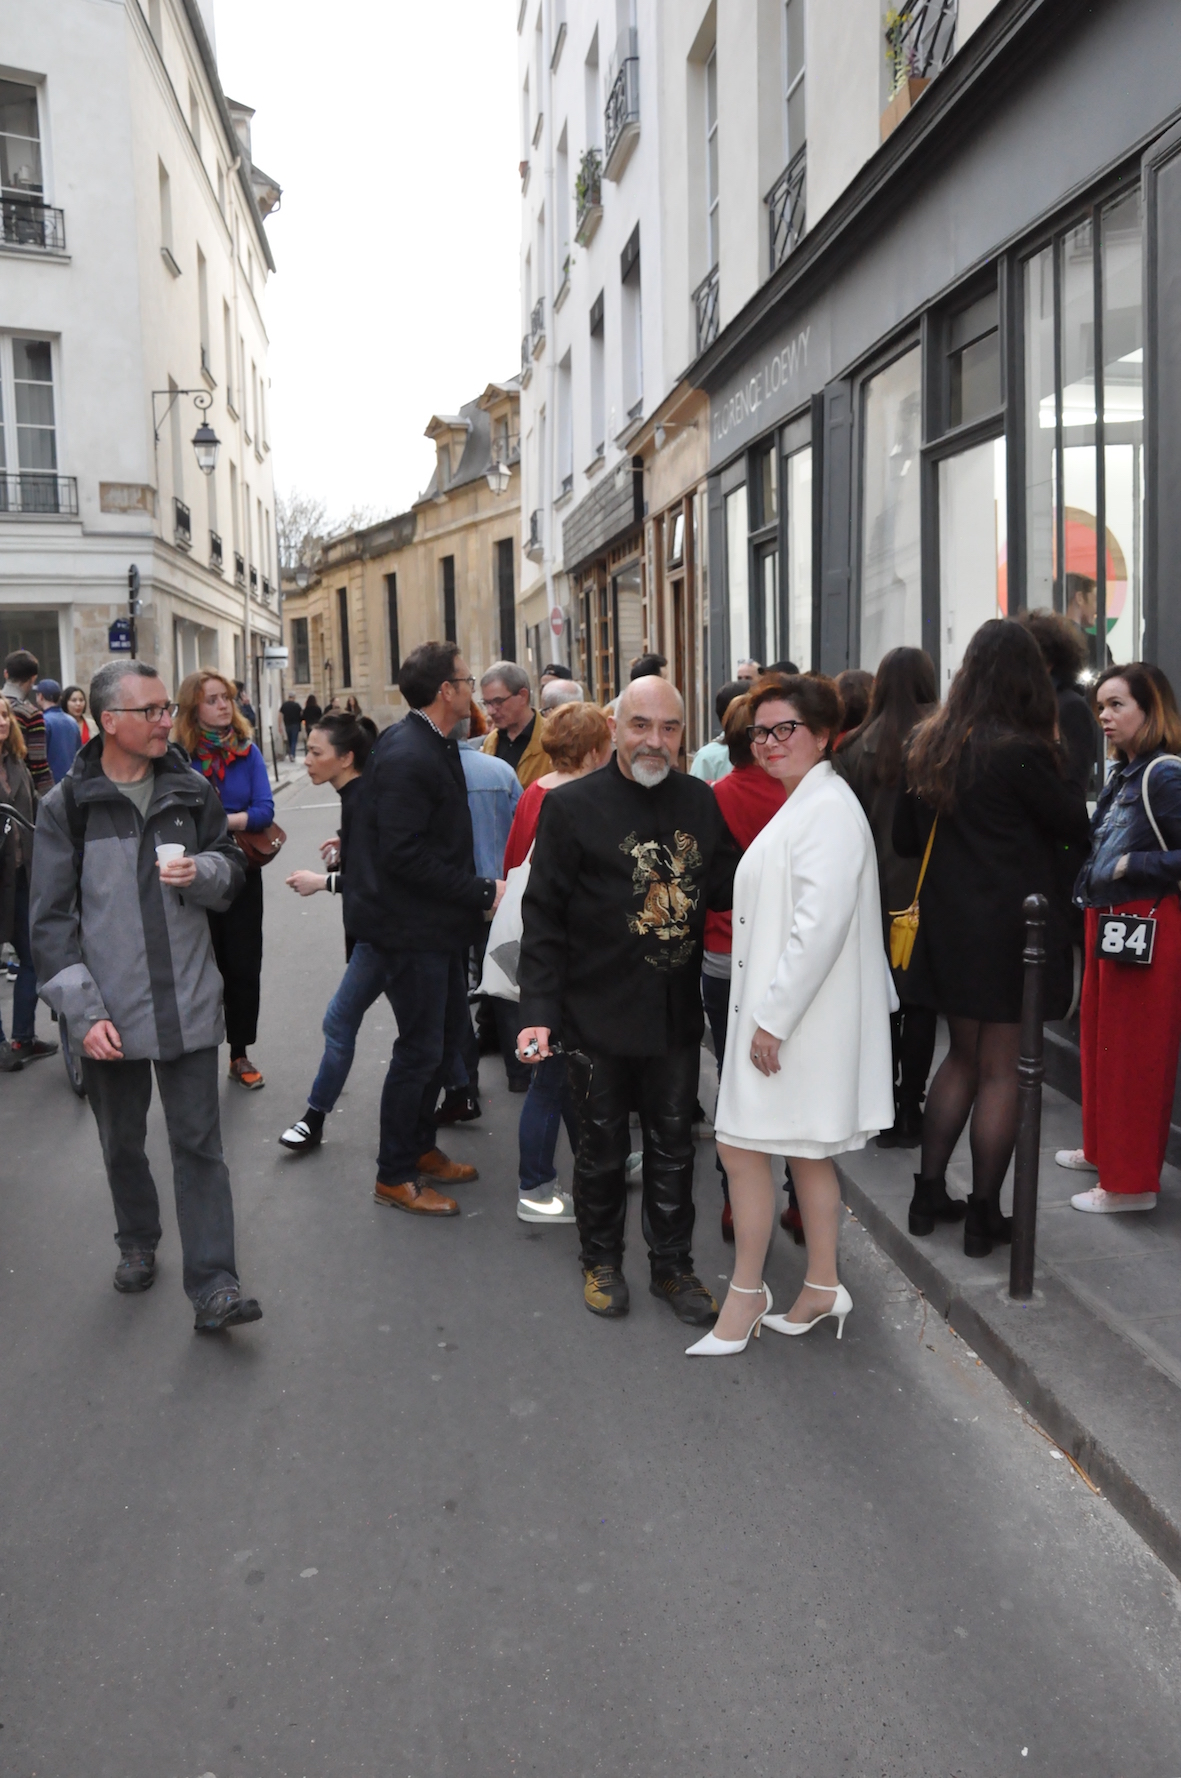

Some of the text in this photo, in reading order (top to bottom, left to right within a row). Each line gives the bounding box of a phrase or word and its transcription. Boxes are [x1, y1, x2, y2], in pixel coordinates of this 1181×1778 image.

[713, 325, 811, 443] FLORENCE LOEWY
[1101, 921, 1147, 956] 84
